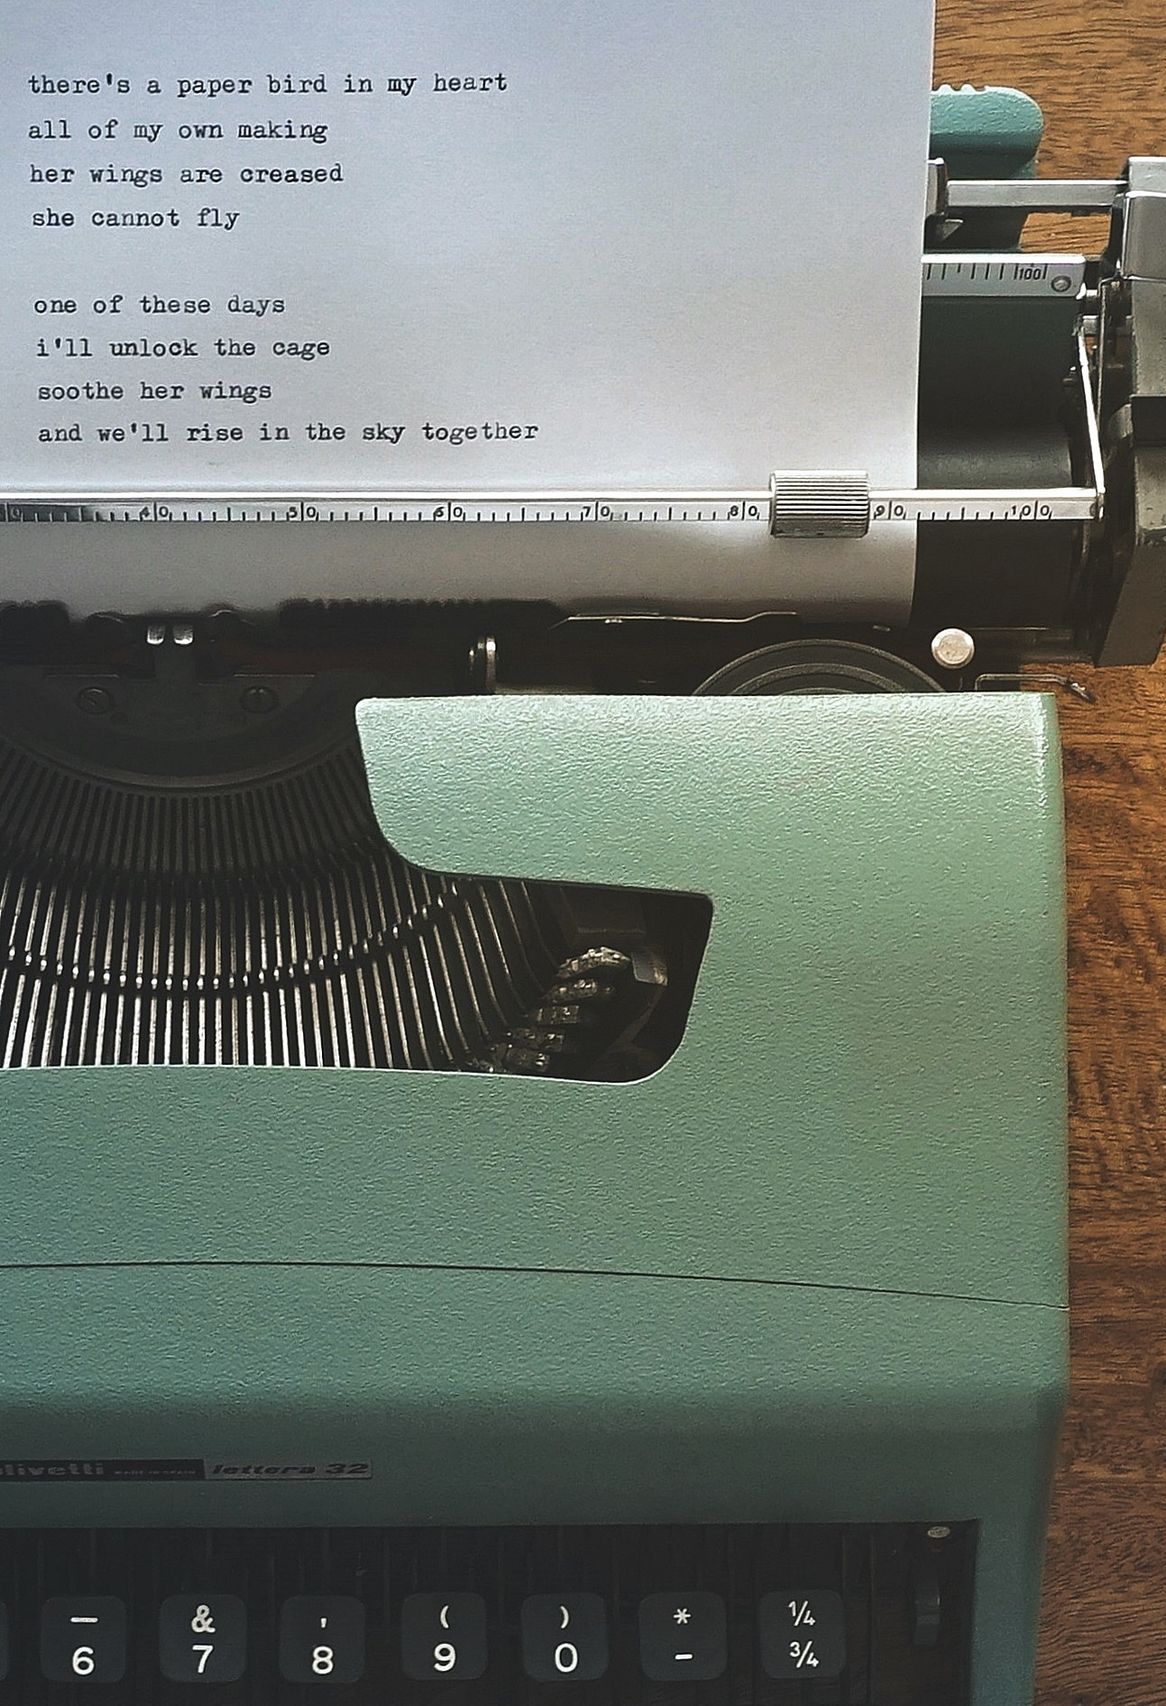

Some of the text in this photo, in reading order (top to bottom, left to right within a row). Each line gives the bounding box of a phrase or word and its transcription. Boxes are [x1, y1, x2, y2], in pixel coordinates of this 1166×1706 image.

[27, 71, 508, 99] there's a paper bird in my heart
[28, 118, 329, 145] all of my own making
[29, 162, 345, 189] her wings are creased
[32, 207, 241, 231] she cannot fly
[1018, 267, 1042, 281] 100
[33, 294, 286, 318] one of these days
[36, 337, 330, 362] i'll unlock the cage
[37, 380, 272, 405] soothe her wings
[37, 421, 540, 446] and we'll rise in the sky together
[0, 1463, 105, 1476] livetti
[325, 1462, 370, 1475] 32
[72, 1646, 95, 1676] 6
[192, 1644, 214, 1674] 7
[311, 1645, 334, 1675] 8
[433, 1642, 457, 1672] 9
